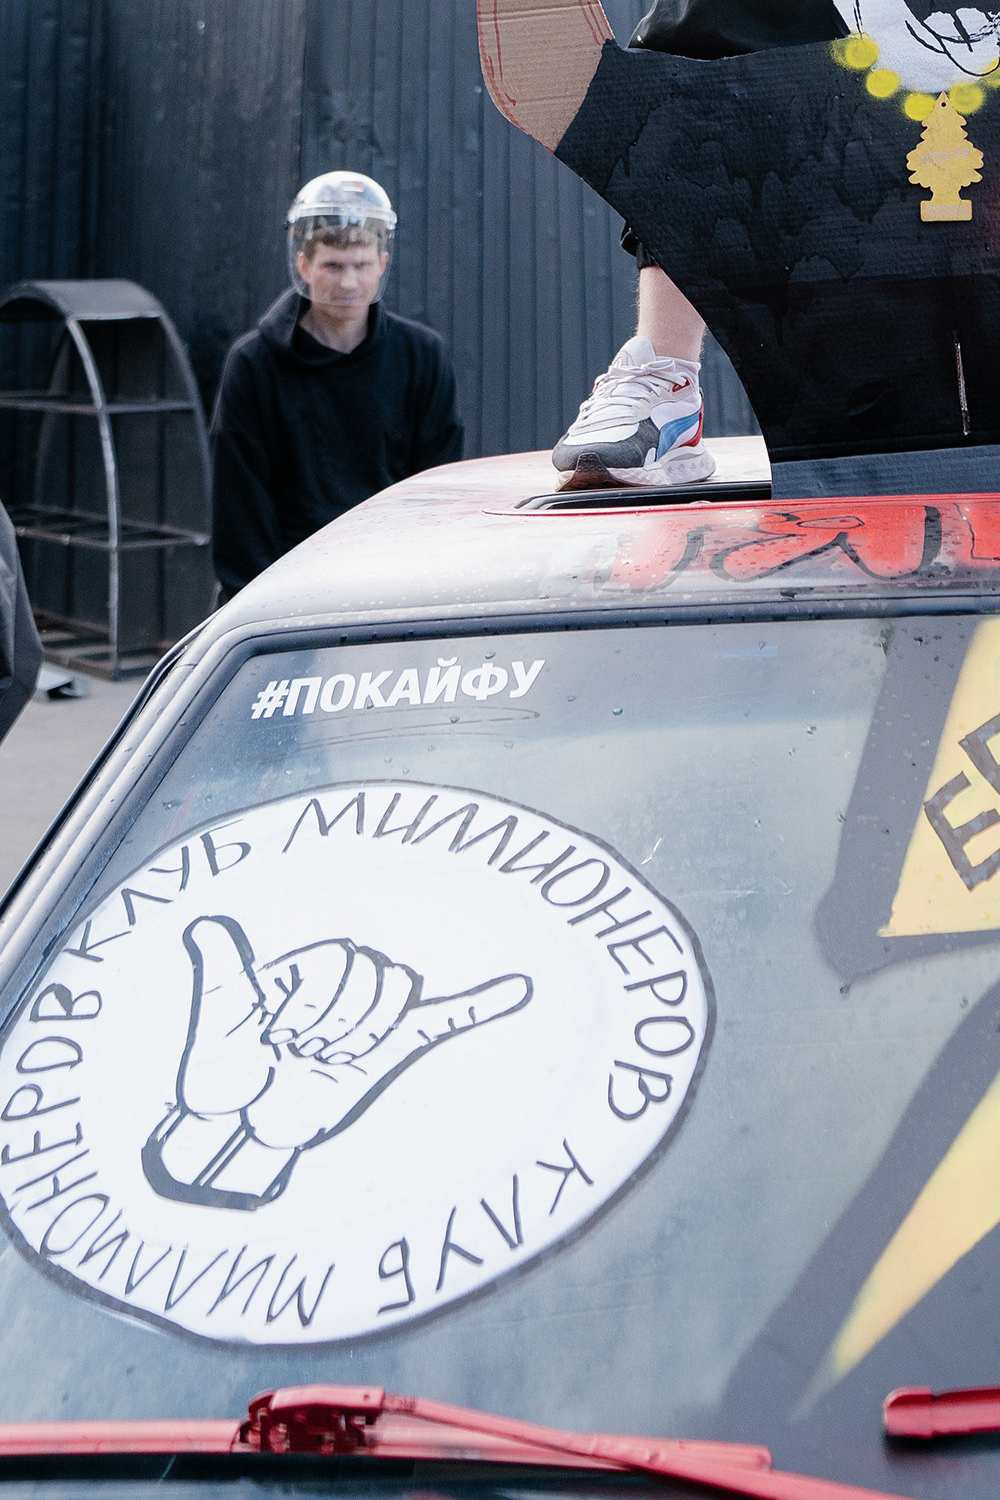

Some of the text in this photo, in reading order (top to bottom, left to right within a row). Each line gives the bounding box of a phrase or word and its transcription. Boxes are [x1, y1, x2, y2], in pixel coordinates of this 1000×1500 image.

[250, 658, 546, 719] #ПОКАЙФУ
[0, 792, 696, 1327] КЛУБ МИЛЛИОНЕРОВ КЛУБ МИЛЛИОНЕРОВ
